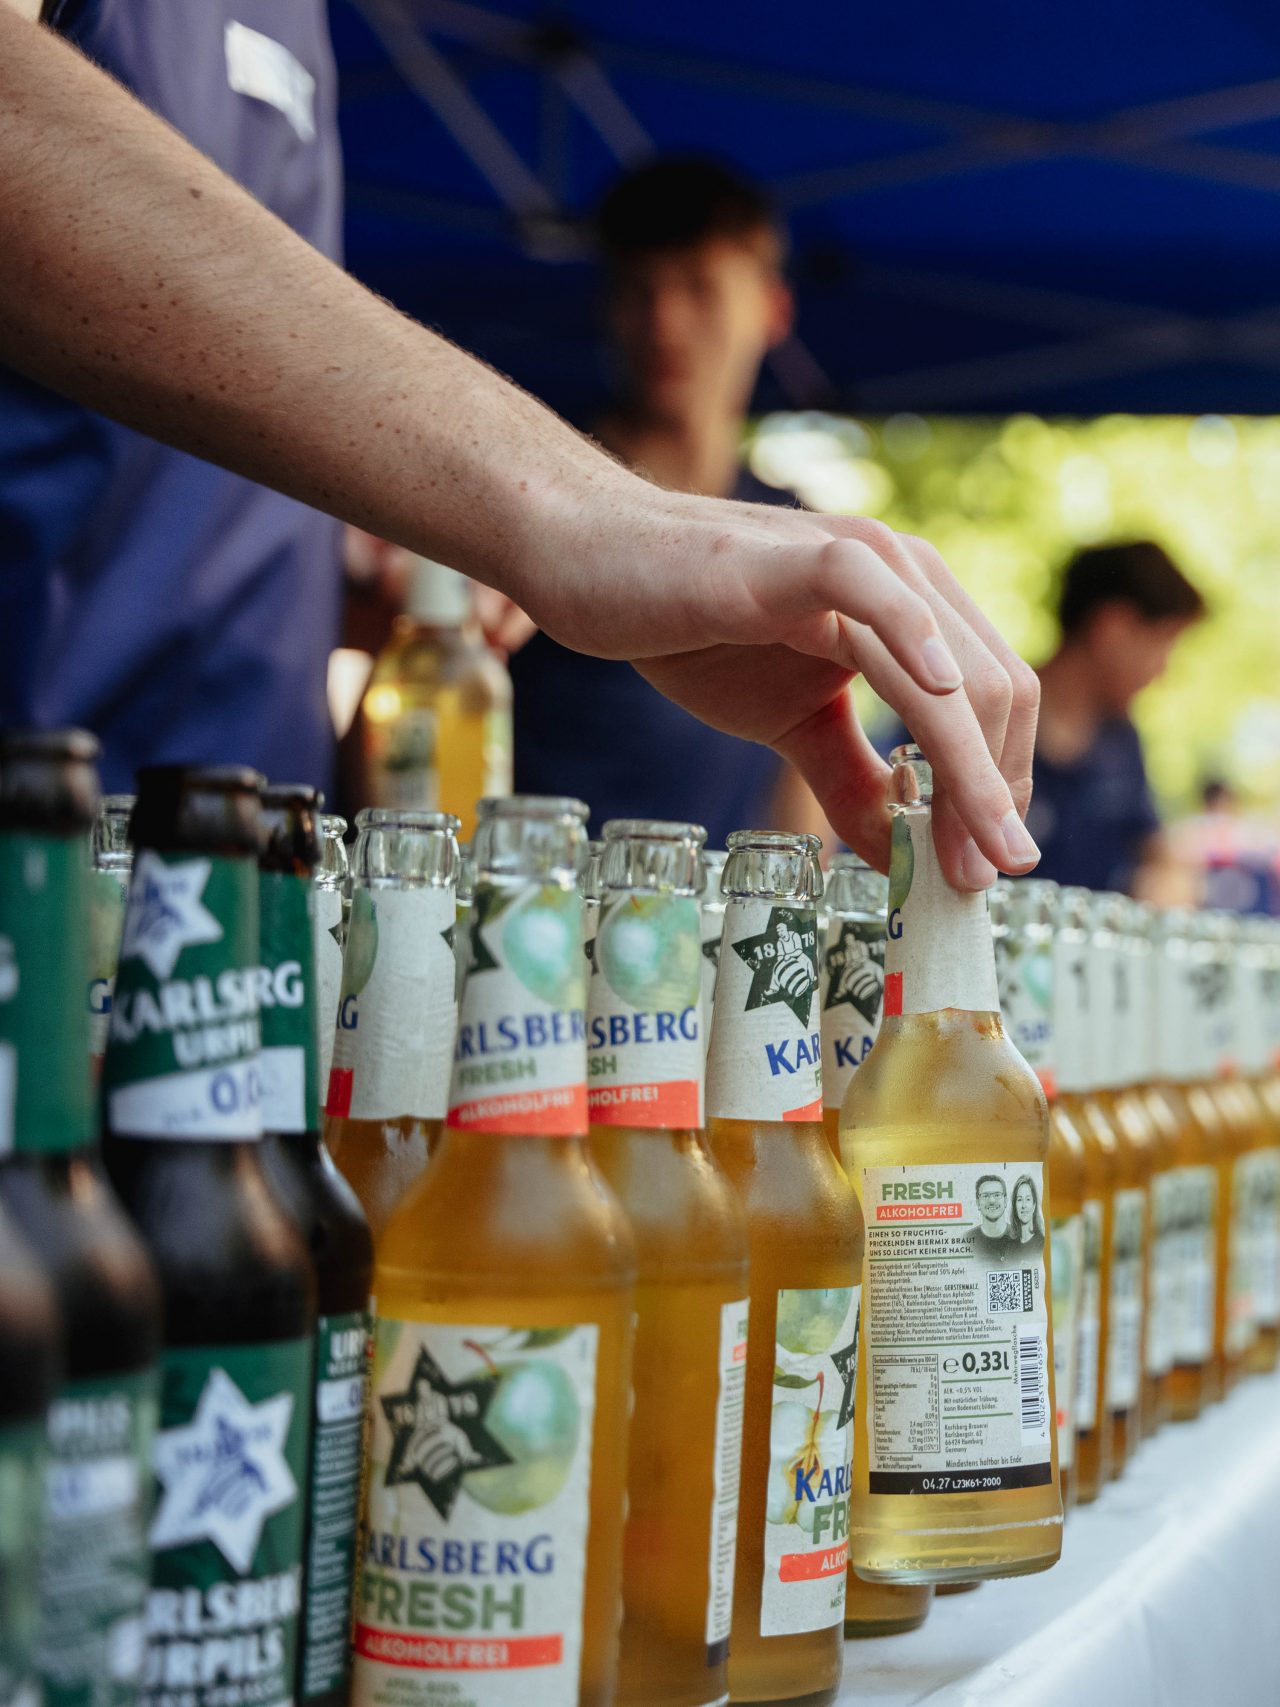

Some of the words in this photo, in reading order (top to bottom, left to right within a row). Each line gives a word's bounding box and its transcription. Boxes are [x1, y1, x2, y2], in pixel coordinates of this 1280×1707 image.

[588, 1006, 698, 1049] SBERG
[765, 1033, 820, 1076] KAR
[882, 1181, 953, 1201] FRESH
[879, 1206, 959, 1218] ALKOHOLFREI
[903, 1229, 947, 1237] FRUCHTIG-
[869, 1239, 915, 1247] PRICKELNDEN
[917, 1238, 949, 1246] BIERMIX
[951, 1237, 975, 1245] BRAUT
[893, 1248, 917, 1256] LEICHT
[919, 1247, 947, 1255] KEINER
[945, 1458, 978, 1468] Mindestens
[980, 1457, 1000, 1466] haltbar
[795, 1463, 853, 1502] KARL
[922, 1477, 950, 1490] 04.27
[366, 1533, 554, 1577] ARLSBERG
[359, 1571, 525, 1632] FRESH
